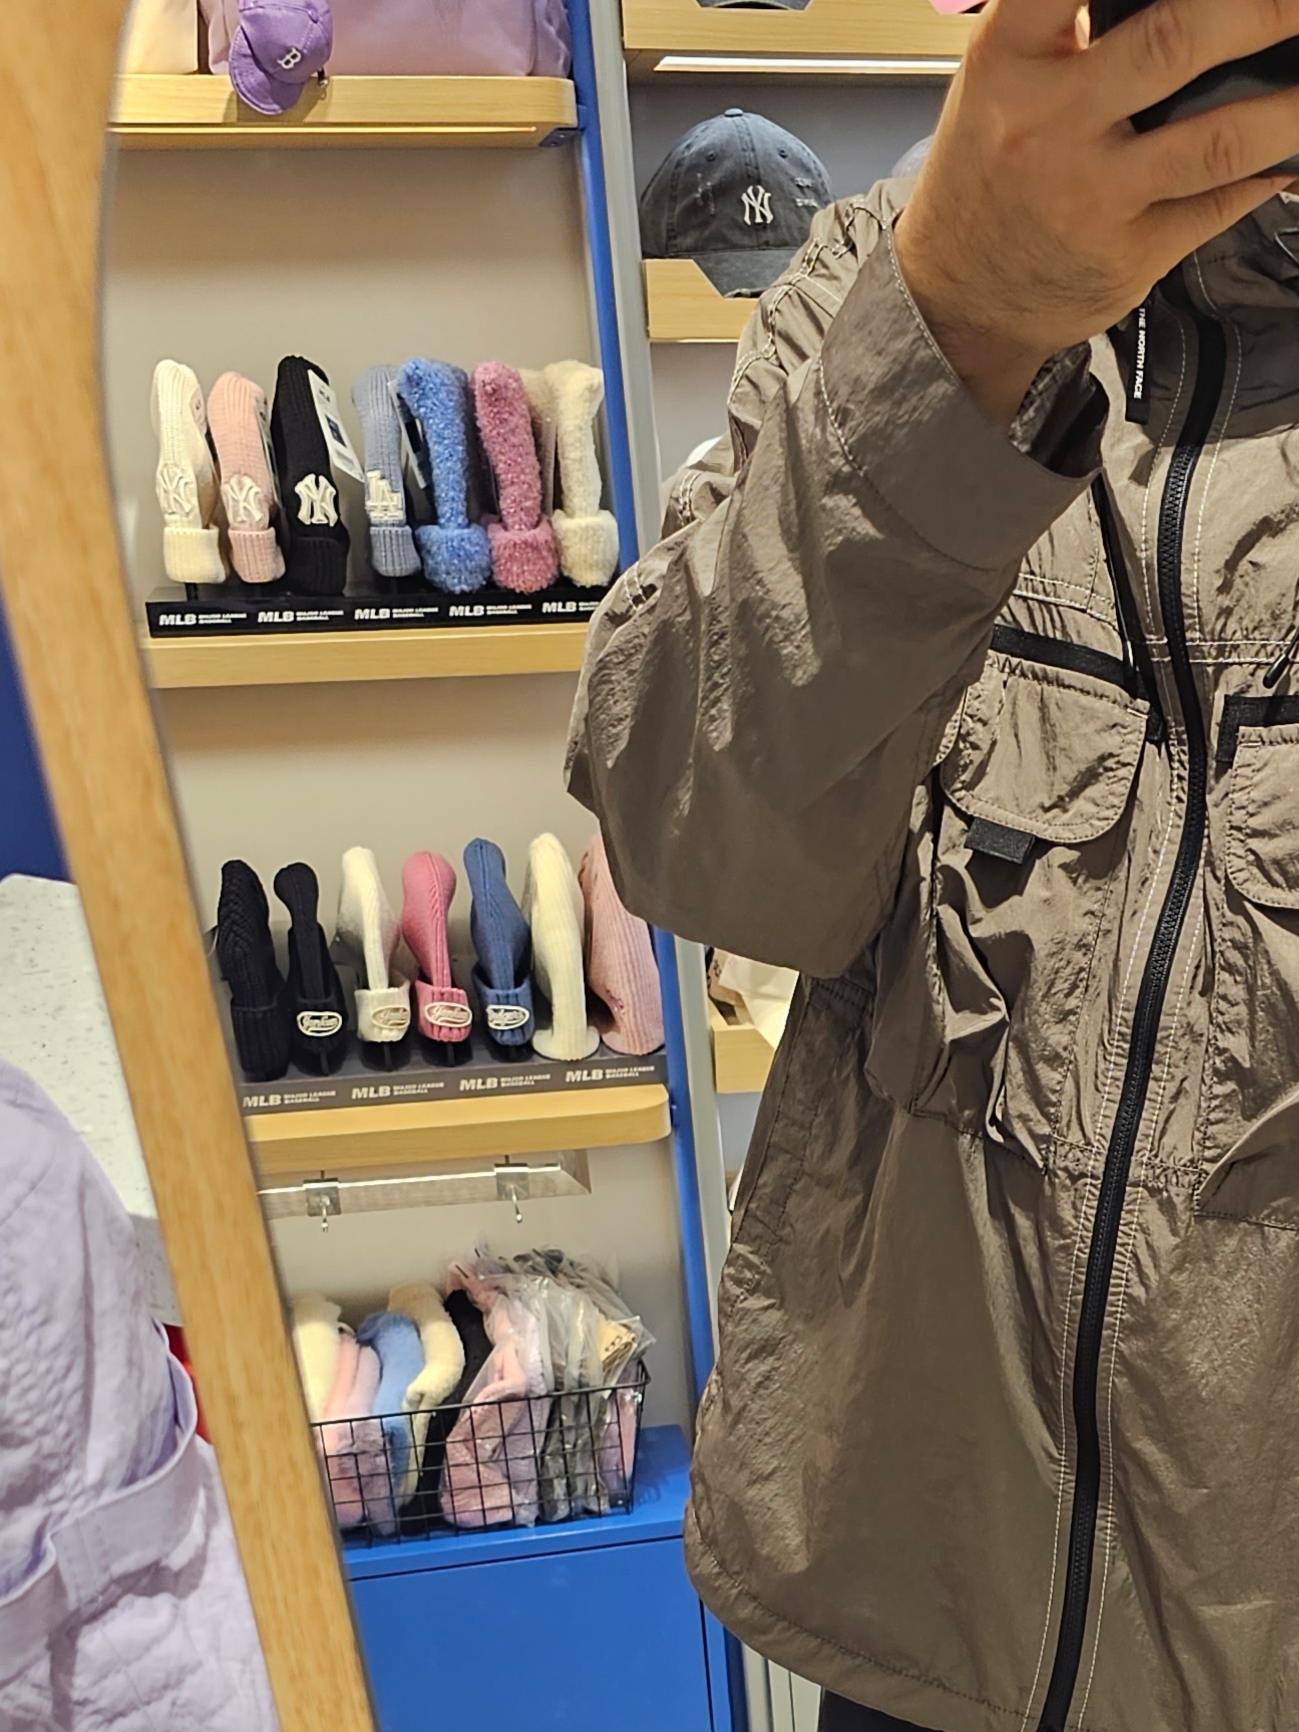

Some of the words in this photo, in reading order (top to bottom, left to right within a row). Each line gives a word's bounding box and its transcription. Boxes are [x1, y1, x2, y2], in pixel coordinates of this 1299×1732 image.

[277, 47, 302, 70] B
[741, 185, 774, 226] NY
[1136, 330, 1146, 369] NORTH
[1133, 370, 1144, 400] FACE
[159, 468, 191, 516] NY
[365, 470, 402, 521] LA
[225, 475, 263, 523] NY
[294, 473, 339, 527] NY
[449, 605, 485, 617] MLB
[542, 601, 577, 613] MLB
[159, 614, 196, 626] MLB
[257, 611, 294, 623] MLB
[354, 608, 390, 620] MLB
[565, 1069, 603, 1082] MLB
[459, 1078, 498, 1091] MLB
[351, 1086, 391, 1099] MLB
[243, 1094, 282, 1107] MLB
